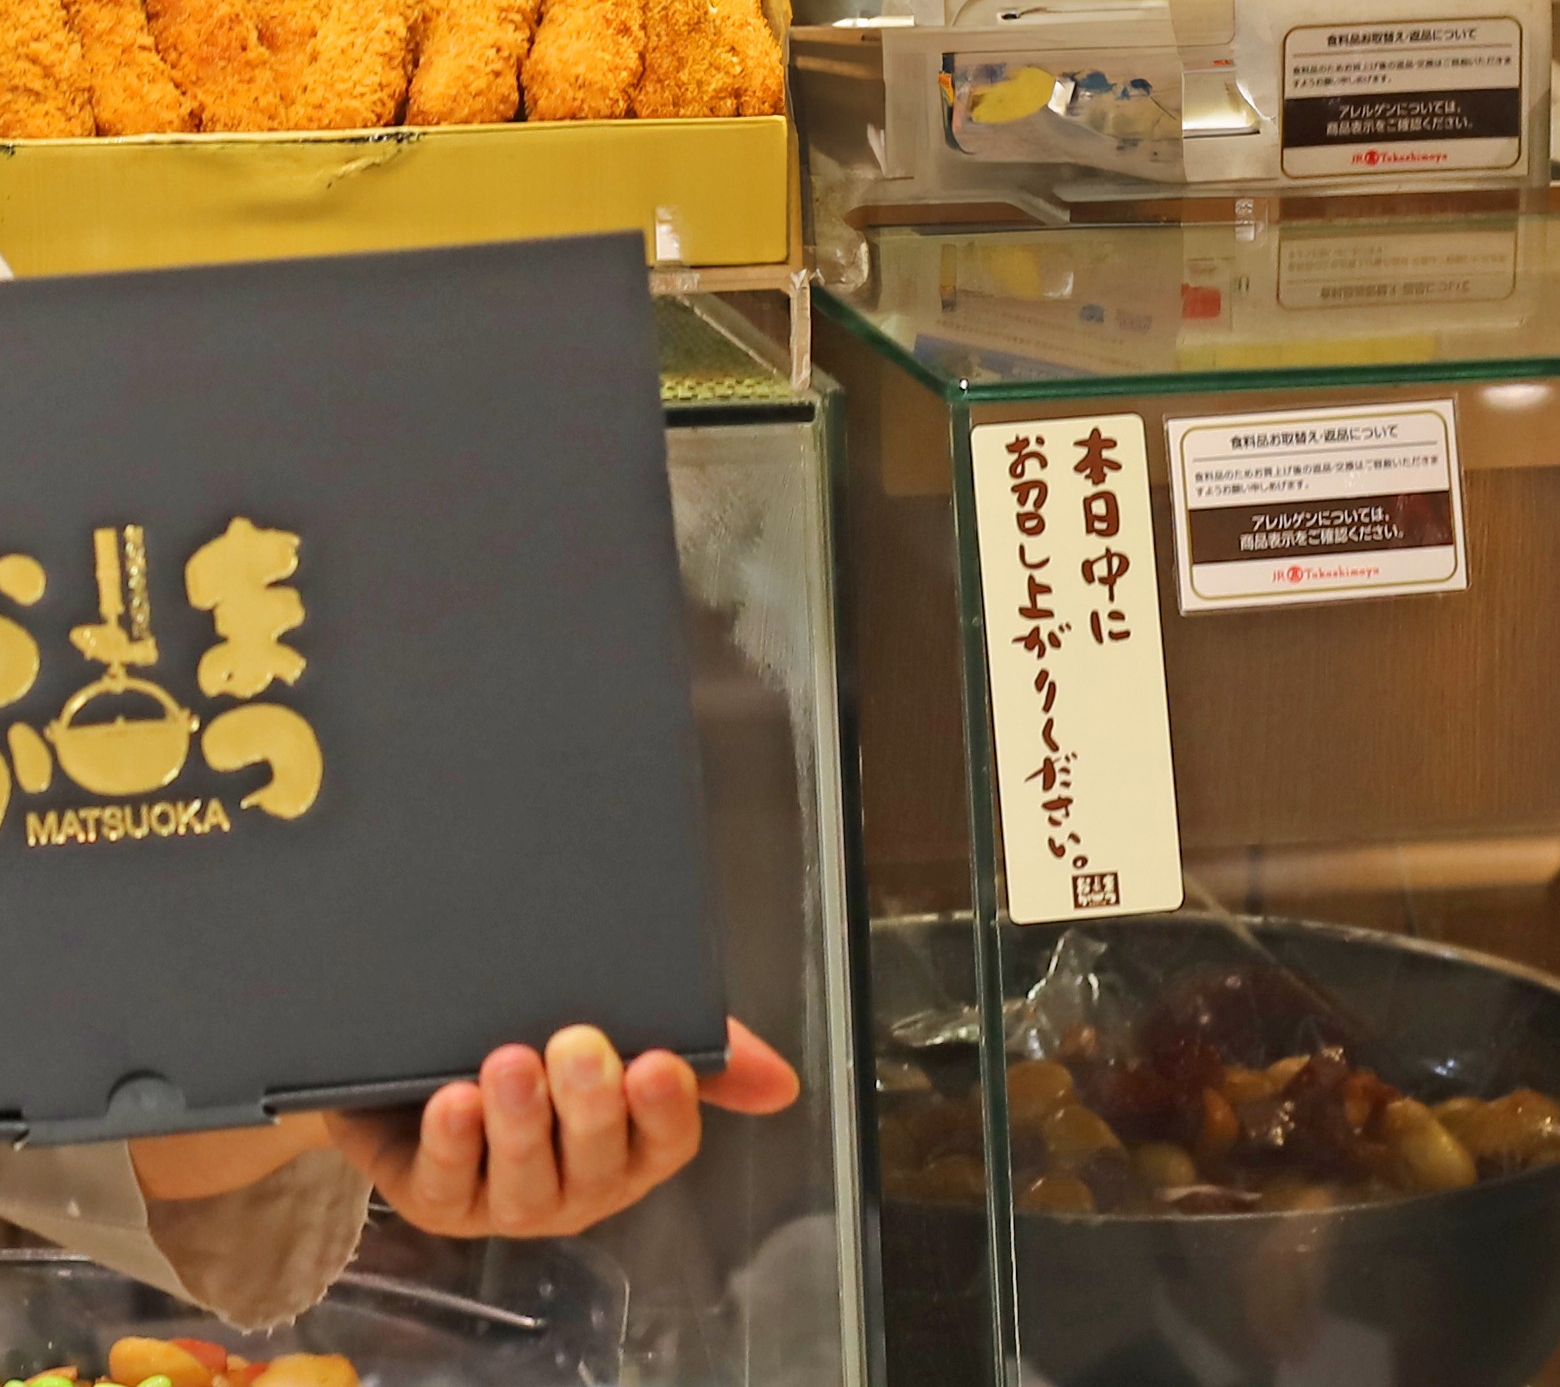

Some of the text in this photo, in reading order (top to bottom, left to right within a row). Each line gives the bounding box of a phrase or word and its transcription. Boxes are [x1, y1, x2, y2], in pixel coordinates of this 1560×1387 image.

[1072, 425, 1132, 646] 本日中に
[1004, 434, 1091, 870] お召し上がりください。
[25, 797, 231, 847] MATSUOKA
